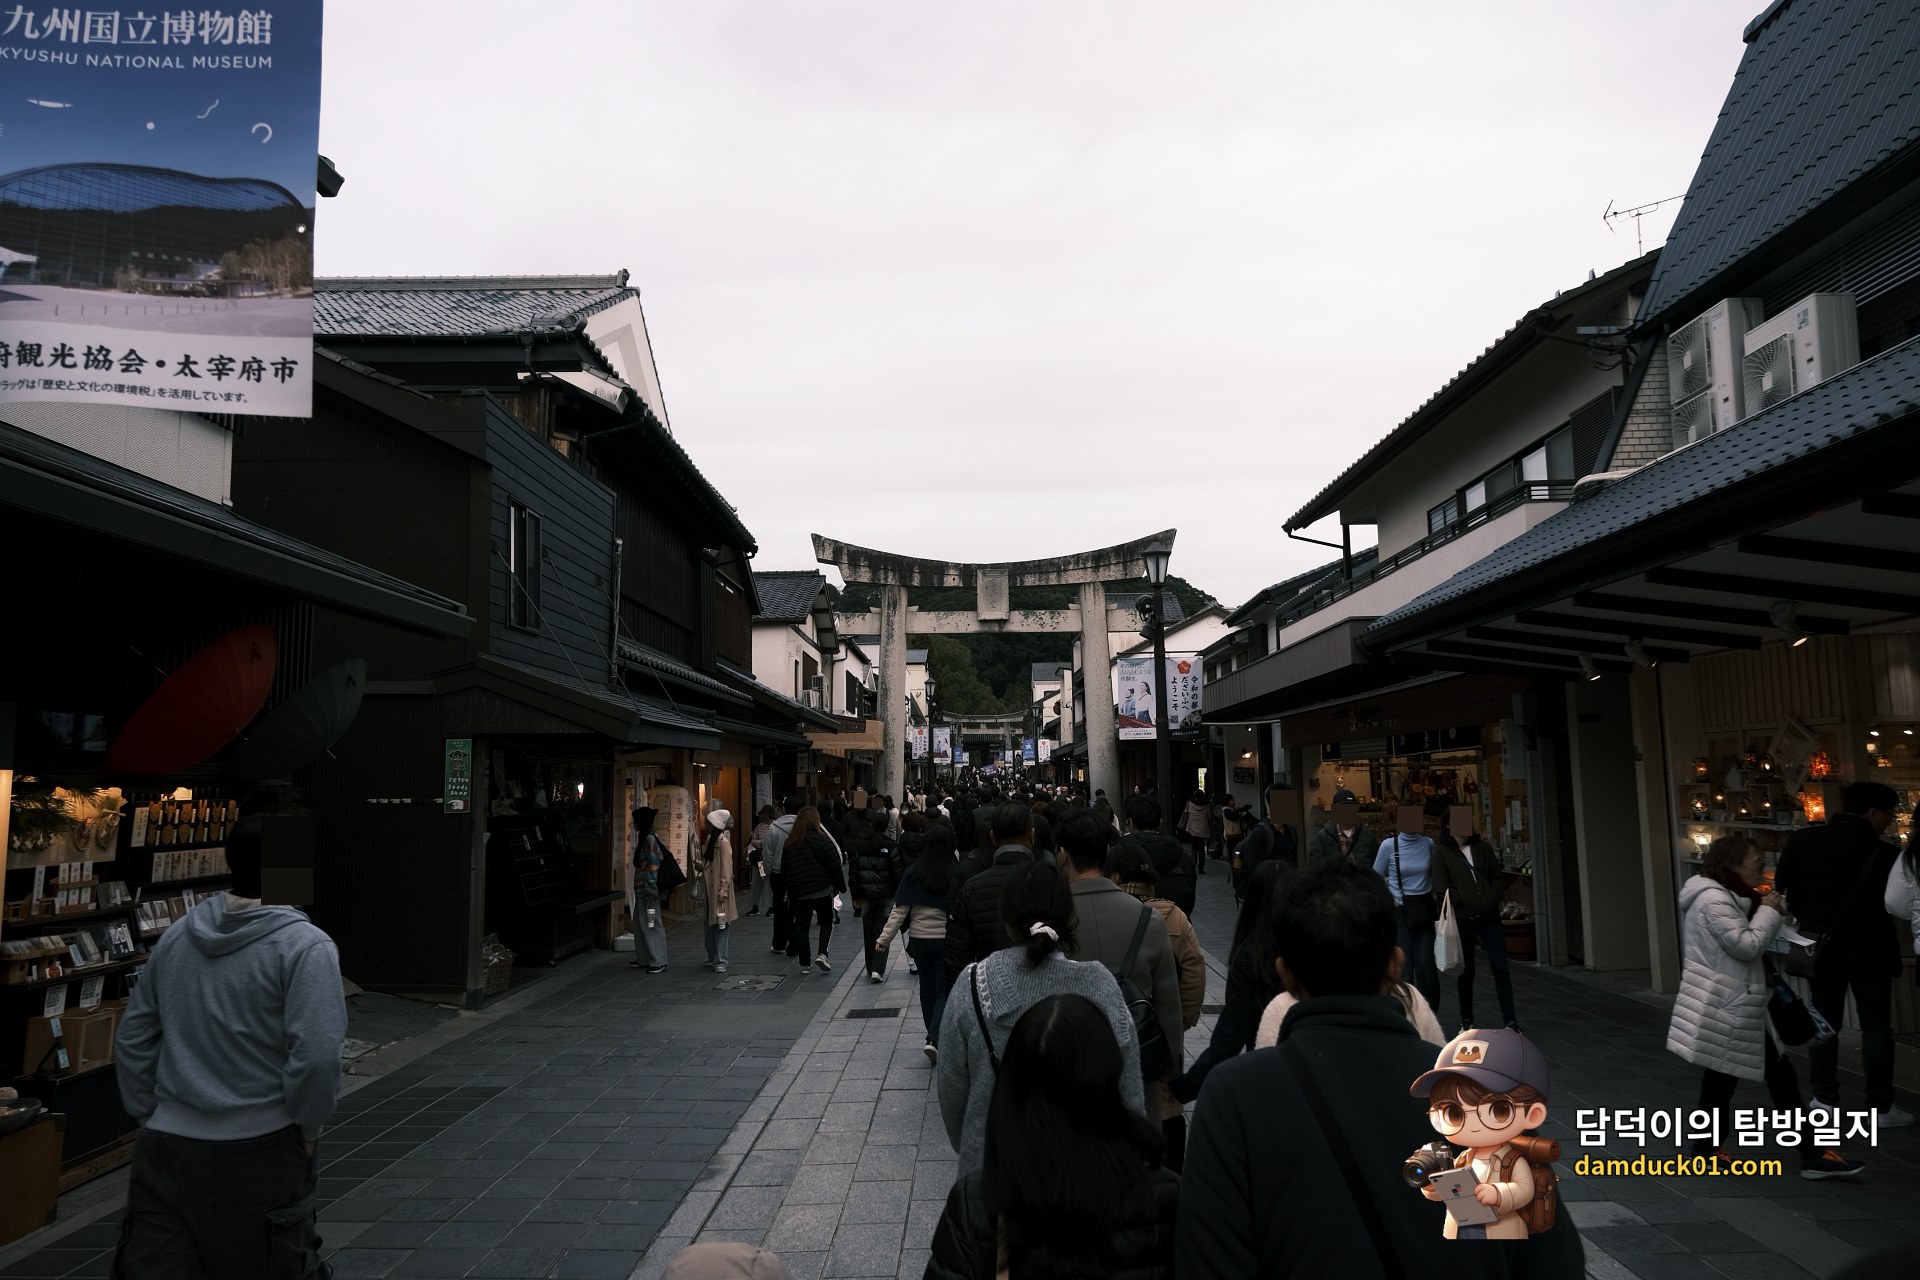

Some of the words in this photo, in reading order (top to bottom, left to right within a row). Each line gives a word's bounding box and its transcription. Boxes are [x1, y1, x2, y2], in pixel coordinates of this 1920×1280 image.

[1, 5, 273, 45] 九州国立博物館
[0, 47, 78, 65] KYUSHU
[86, 53, 185, 69] NATIONAL
[193, 56, 272, 69] MUSEUM
[0, 378, 248, 403] ラッグは「歴史と文化の環境税」を活用しています。
[1171, 676, 1179, 711] ようこそ
